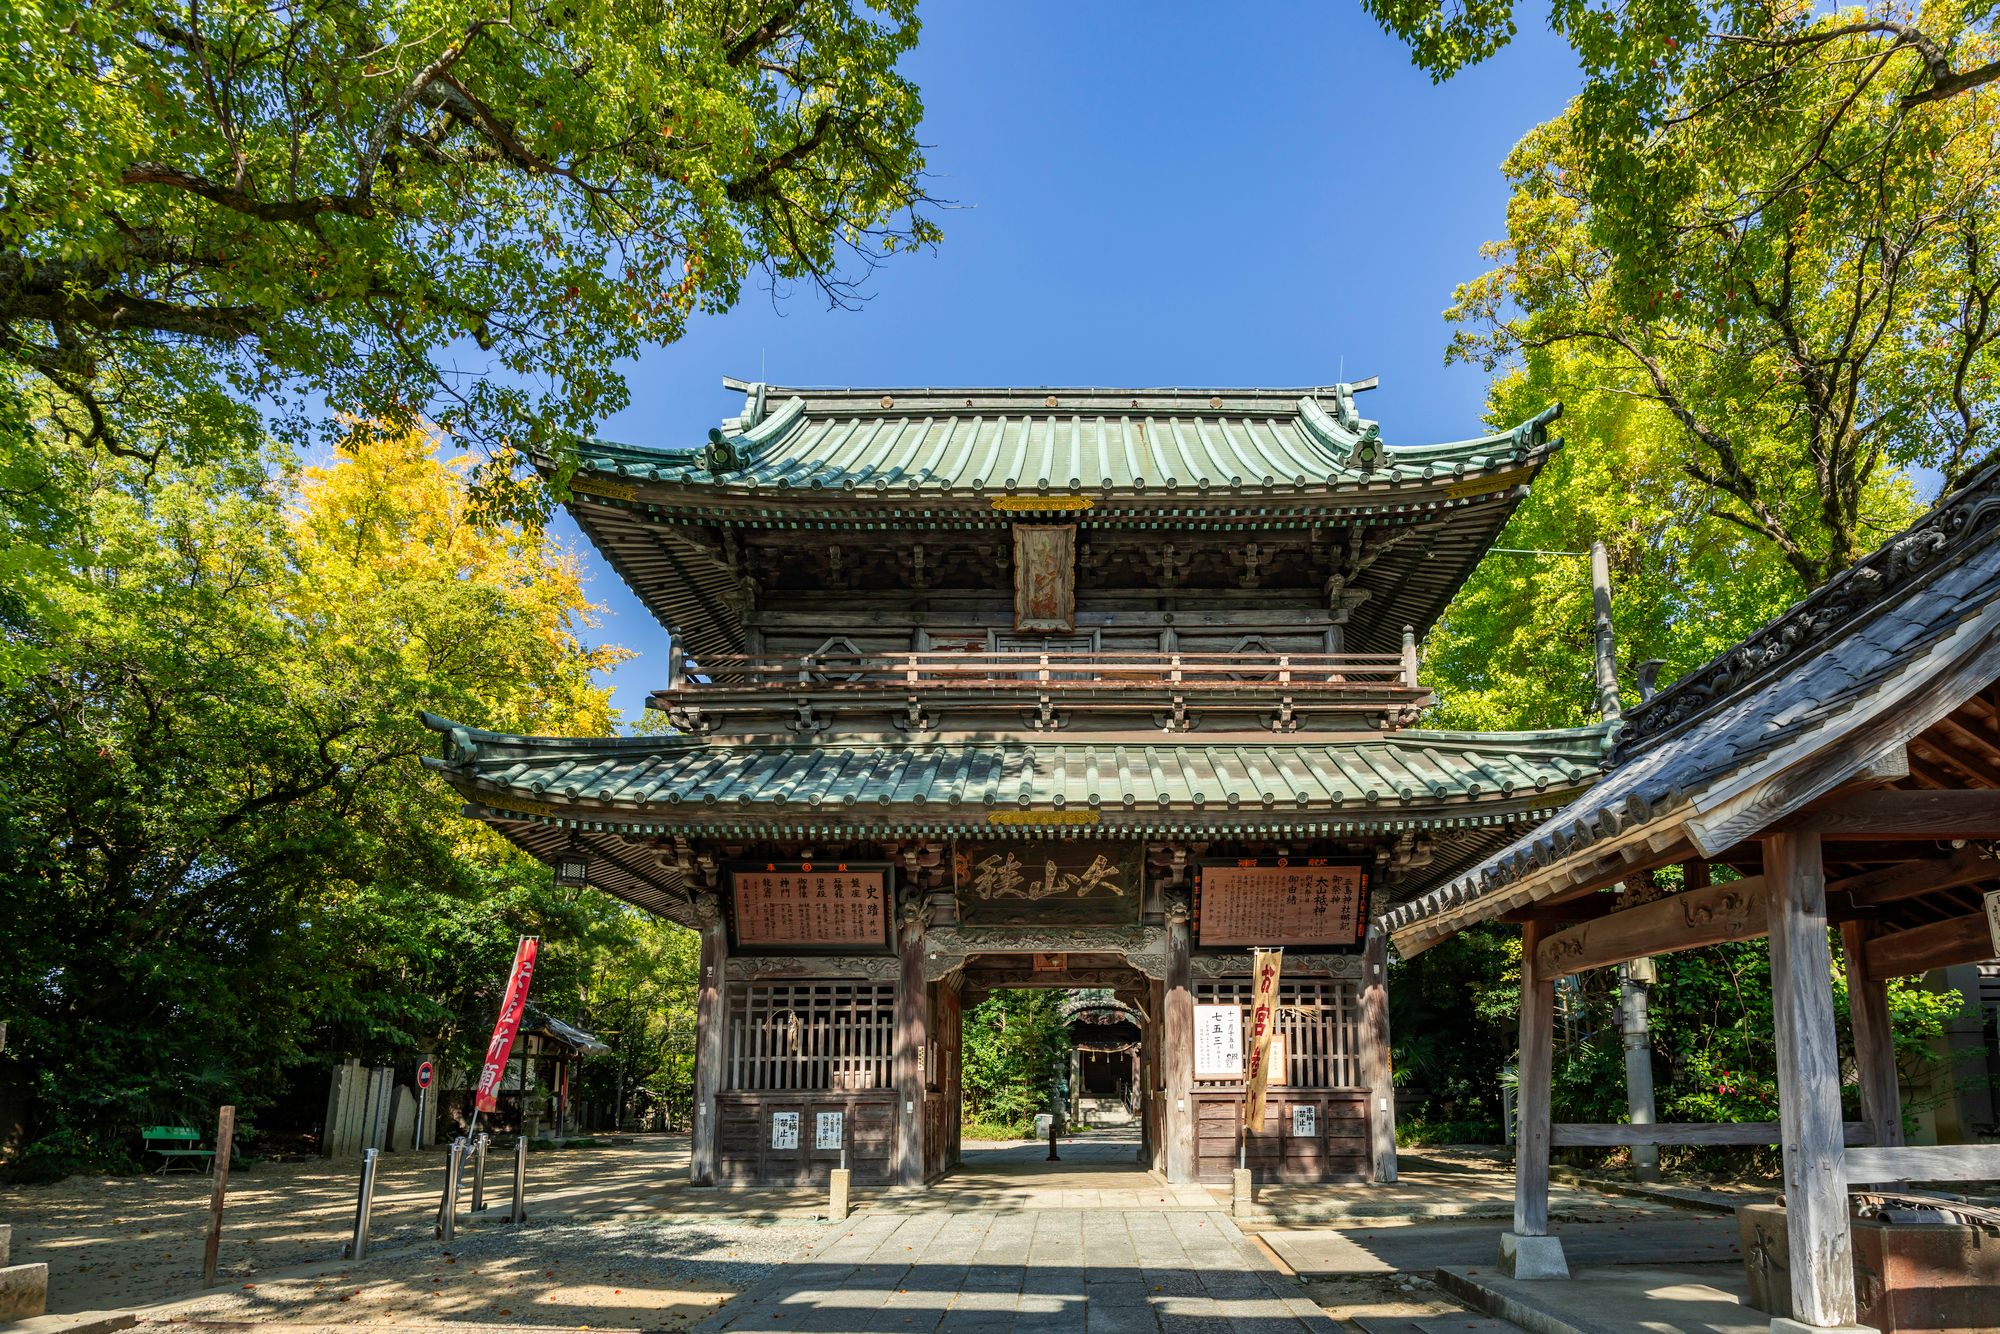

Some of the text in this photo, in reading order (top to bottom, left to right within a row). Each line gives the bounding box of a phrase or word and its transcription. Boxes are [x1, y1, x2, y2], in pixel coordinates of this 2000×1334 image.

[780, 877, 790, 898] 神門
[1313, 876, 1329, 916] 大山祇神
[1330, 875, 1342, 904] 御祭神
[1211, 1011, 1224, 1046] 七五三
[1251, 964, 1275, 1121] お宮参り
